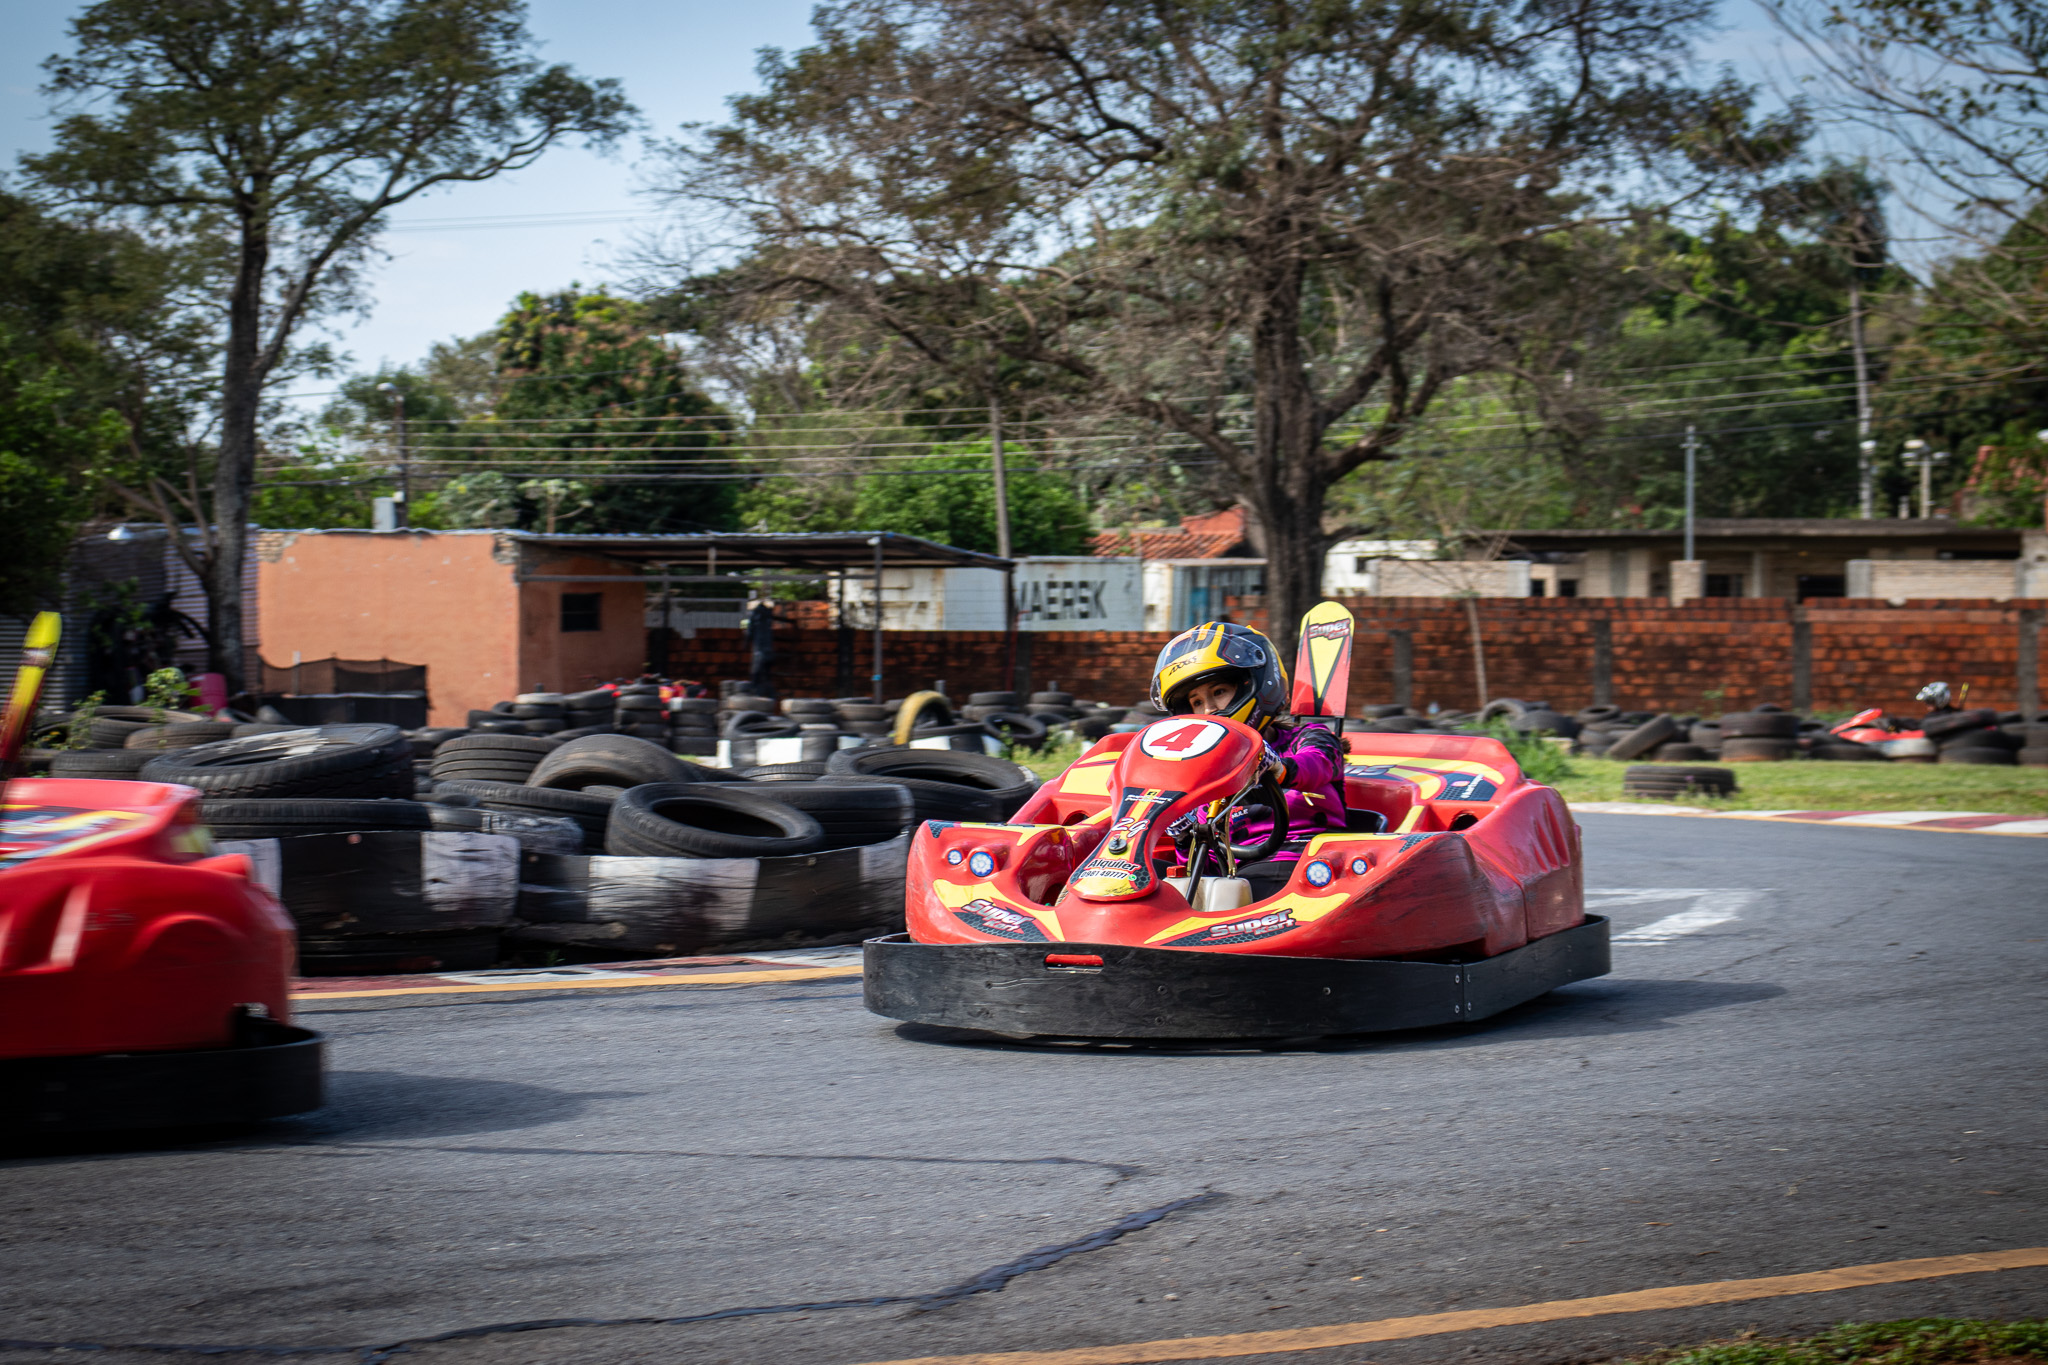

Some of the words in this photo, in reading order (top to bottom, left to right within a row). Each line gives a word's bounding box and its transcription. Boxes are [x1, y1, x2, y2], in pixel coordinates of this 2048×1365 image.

[1309, 620, 1349, 638] Super
[1149, 724, 1209, 752] 4
[1087, 859, 1139, 871] Alquiler
[963, 899, 1035, 926] Super
[1211, 909, 1292, 937] Super
